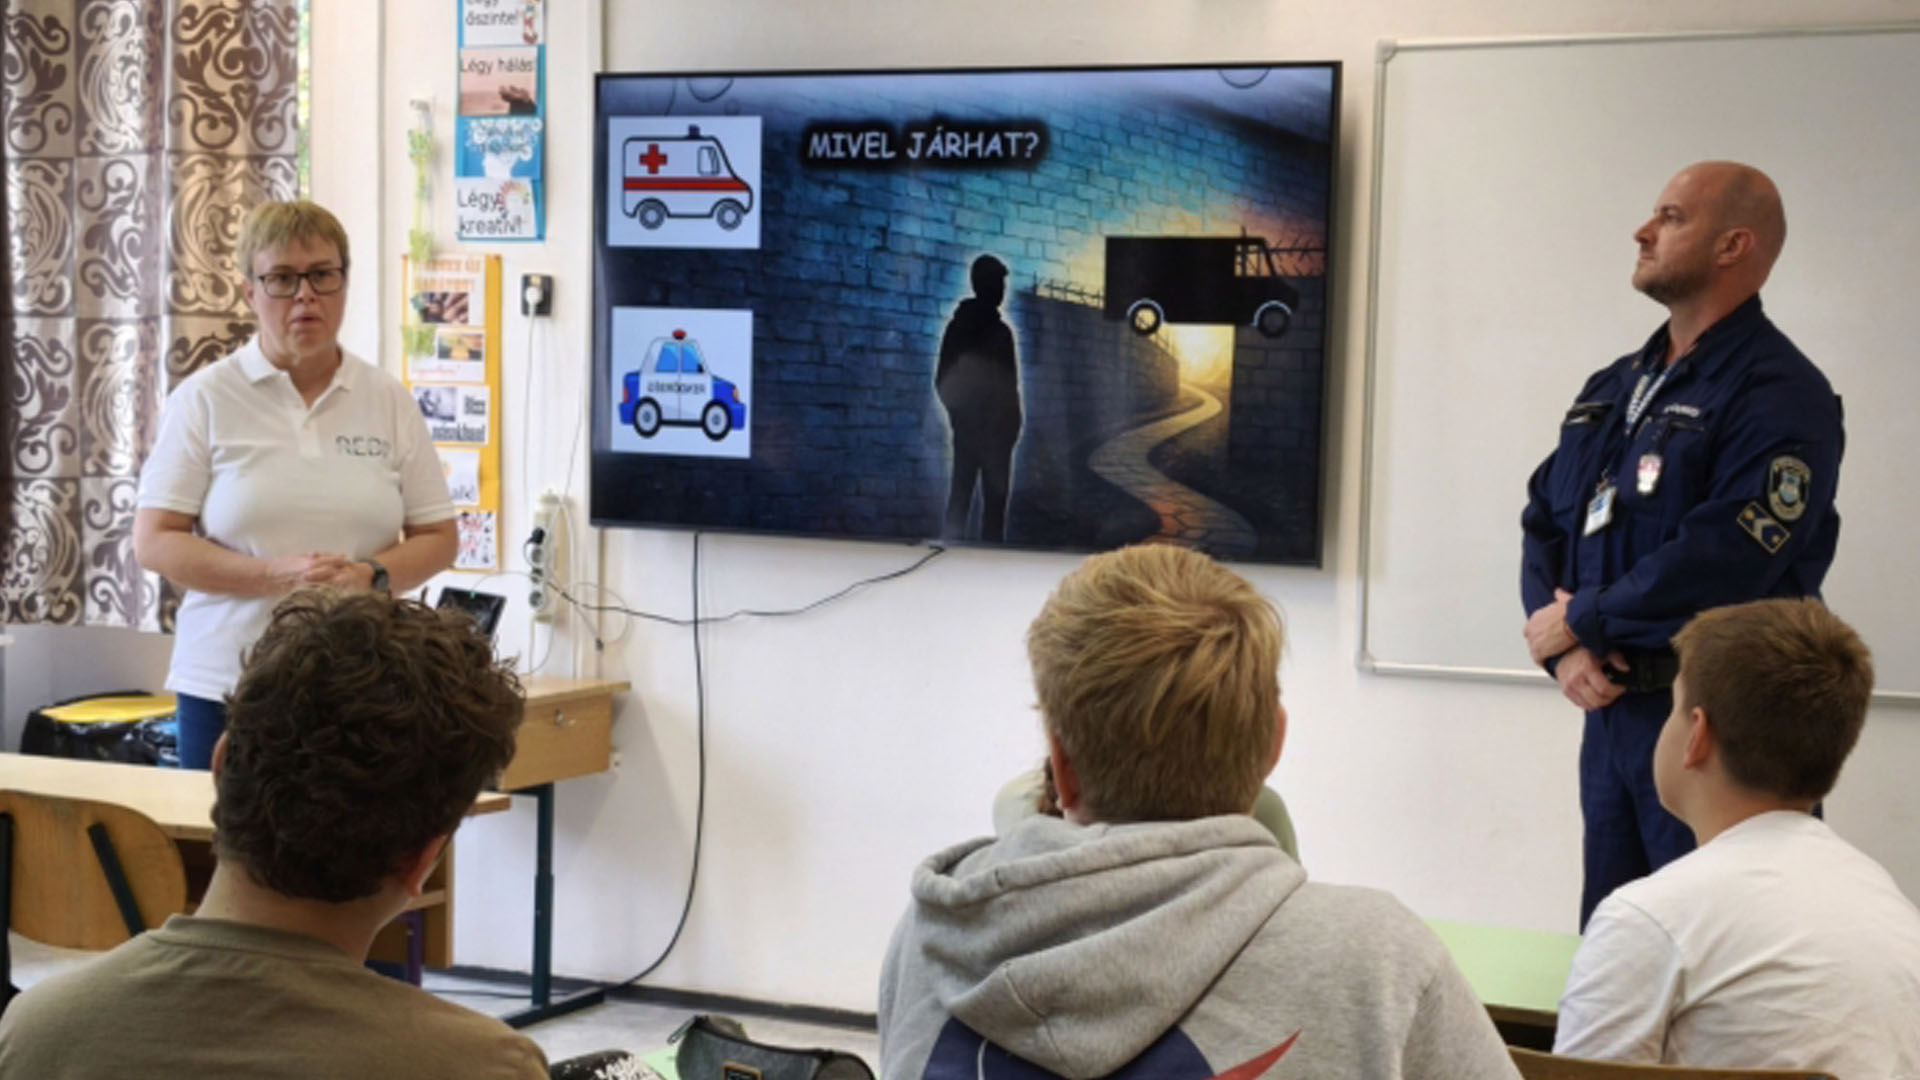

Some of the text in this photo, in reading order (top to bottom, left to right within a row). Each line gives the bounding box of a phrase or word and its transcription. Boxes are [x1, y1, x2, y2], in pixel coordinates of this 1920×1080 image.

[459, 58, 493, 76] Légy
[809, 125, 1039, 158] MIVEL JÁRHAT?
